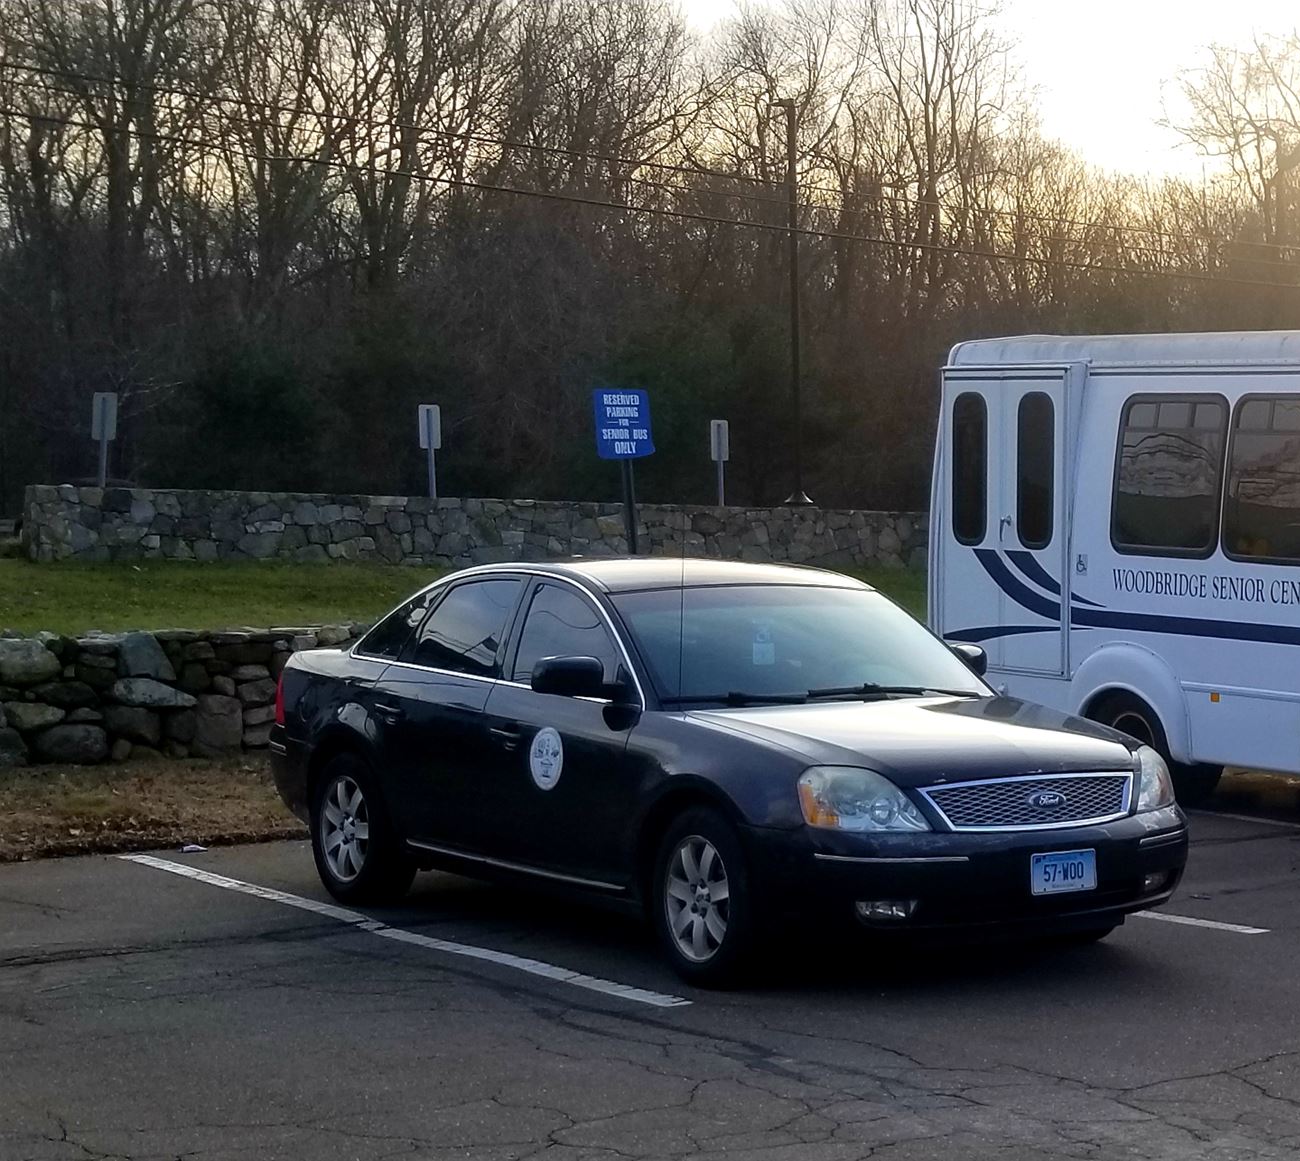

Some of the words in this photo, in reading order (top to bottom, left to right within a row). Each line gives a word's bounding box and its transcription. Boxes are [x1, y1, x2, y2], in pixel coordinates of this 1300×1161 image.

[603, 394, 640, 405] RESERVED
[606, 407, 639, 417] PARKING
[602, 429, 630, 439] SENIOR
[633, 429, 648, 439] BUS
[614, 441, 637, 454] ONLY
[1112, 568, 1208, 598] WOODBRIDGE
[1212, 575, 1266, 602] SENIOR
[1039, 794, 1059, 805] Ford
